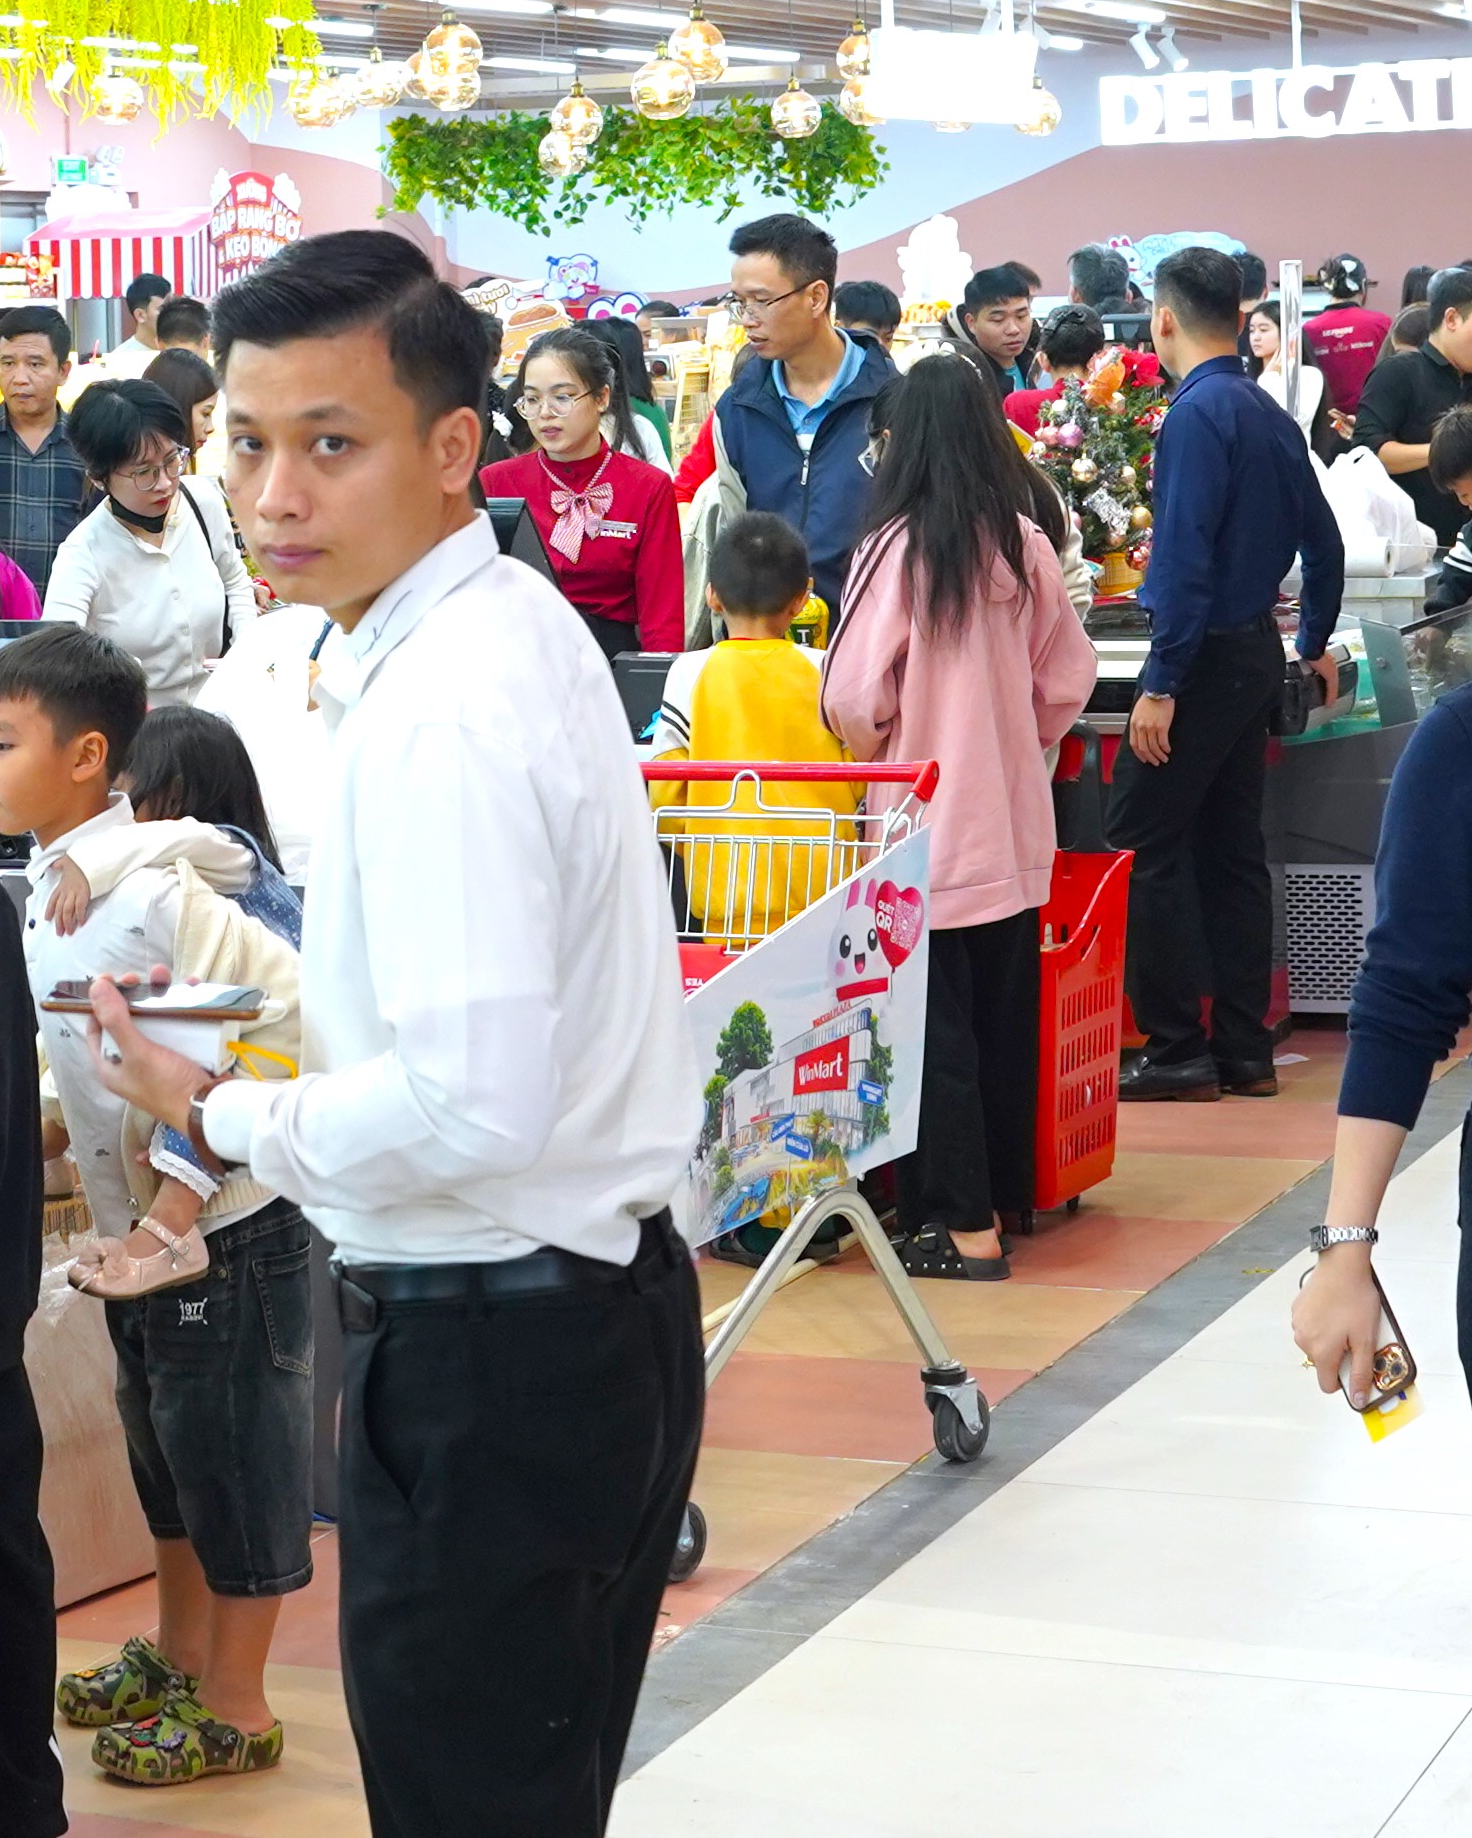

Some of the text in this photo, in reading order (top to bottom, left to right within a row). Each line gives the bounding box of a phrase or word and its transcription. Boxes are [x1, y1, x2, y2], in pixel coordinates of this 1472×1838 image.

[875, 910, 893, 933] QR
[798, 1052, 844, 1086] WinMart
[179, 1301, 205, 1316] 1977
